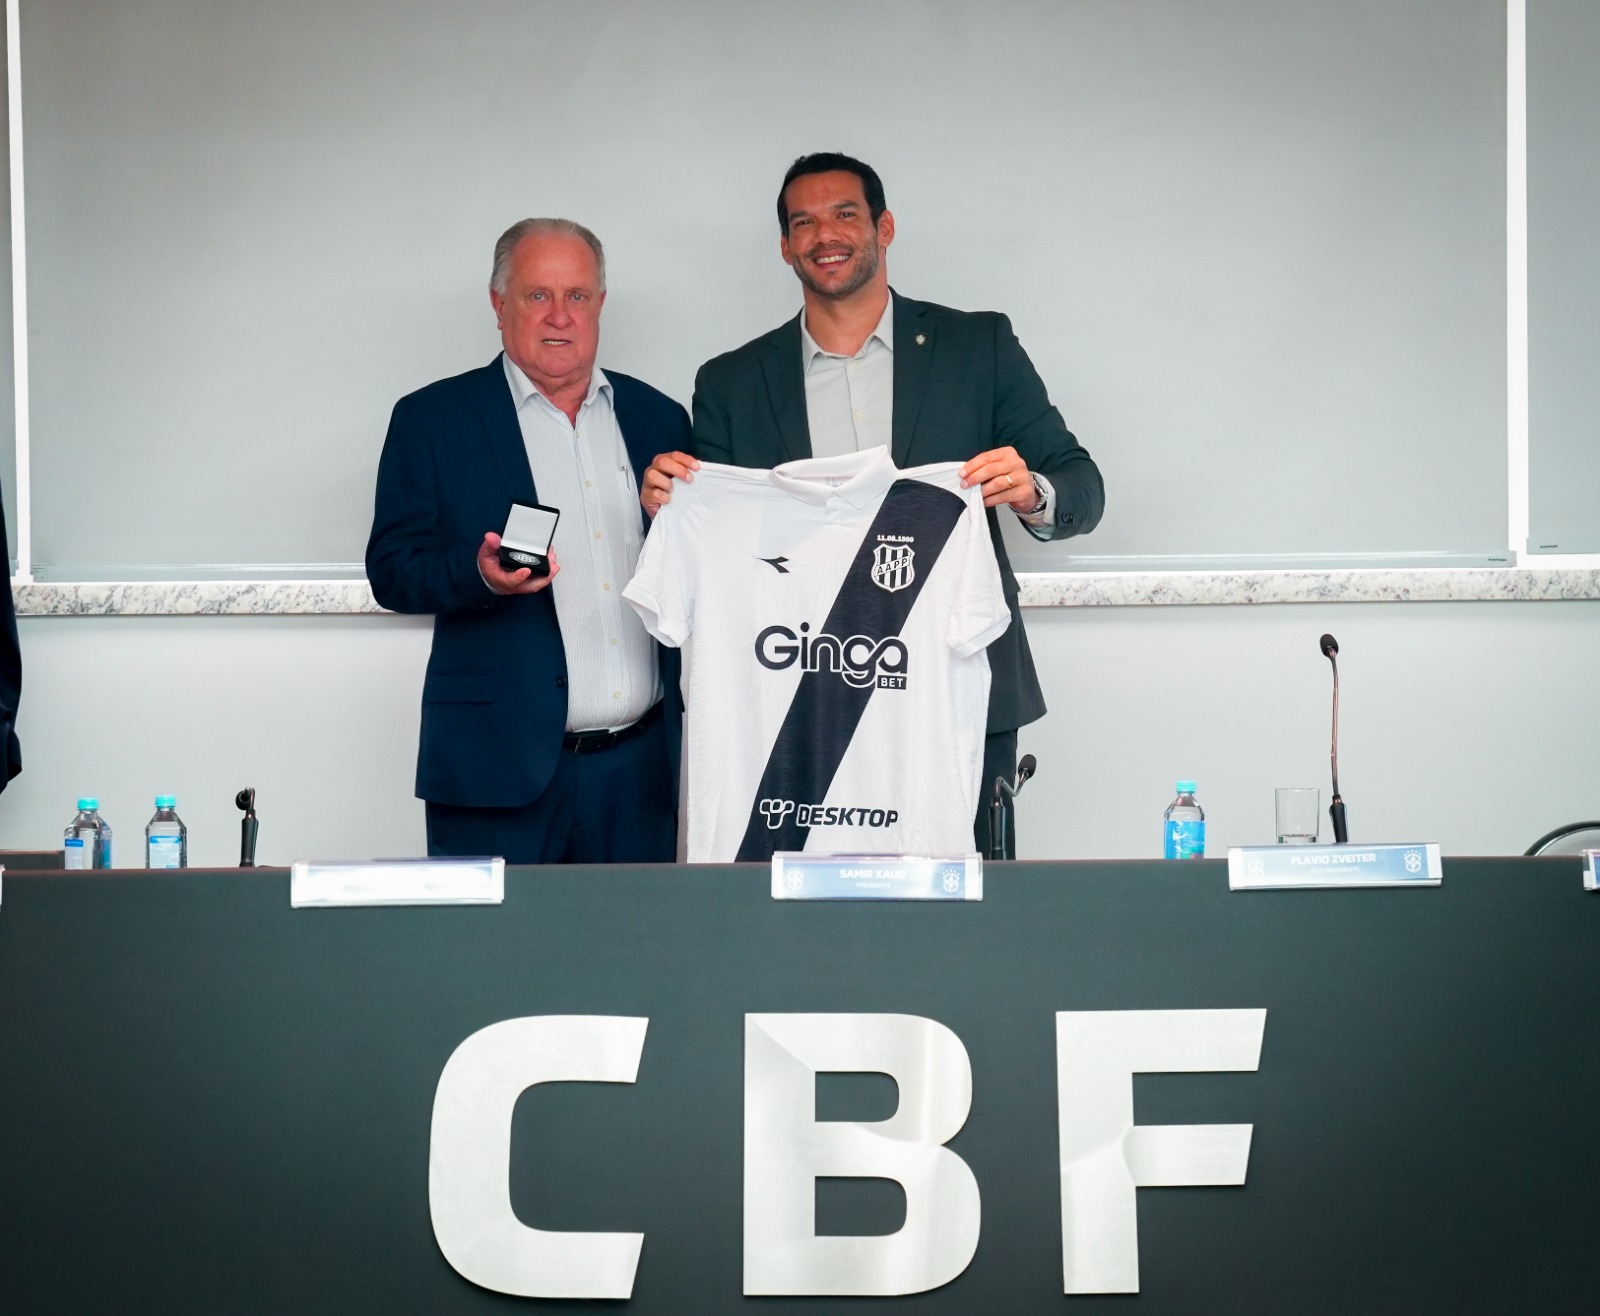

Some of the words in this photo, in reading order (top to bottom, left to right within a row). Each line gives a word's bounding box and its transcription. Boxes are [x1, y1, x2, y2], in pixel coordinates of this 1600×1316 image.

[877, 558, 908, 575] AAPP
[754, 621, 909, 688] Ginga
[880, 677, 904, 687] BET
[797, 804, 899, 828] DESKTOP
[1331, 852, 1377, 864] ZVEITER
[839, 869, 874, 879] SAMIR
[875, 869, 907, 879] XAUD
[428, 1007, 1268, 1300] CBF
